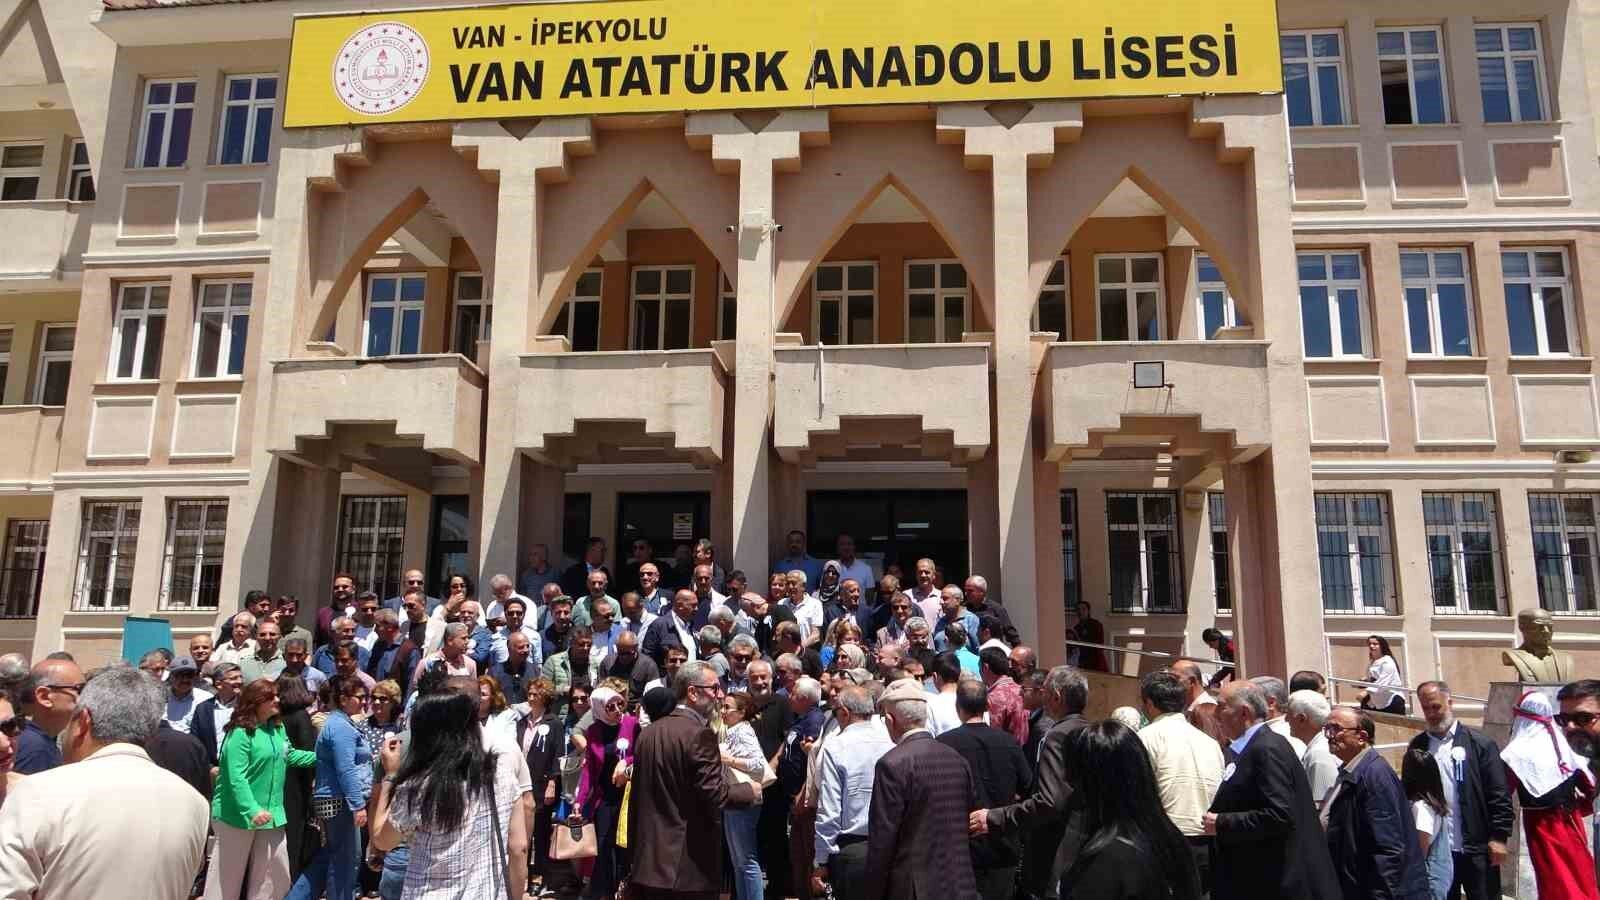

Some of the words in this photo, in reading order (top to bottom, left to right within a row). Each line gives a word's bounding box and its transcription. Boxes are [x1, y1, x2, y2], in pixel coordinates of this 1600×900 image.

[452, 25, 506, 49] VAN
[531, 17, 667, 46] İPEKYOLU
[449, 61, 545, 103] VAN
[560, 44, 789, 99] ATATÜRK
[804, 40, 1052, 91] ANADOLU
[1072, 24, 1238, 81] LİSESİ
